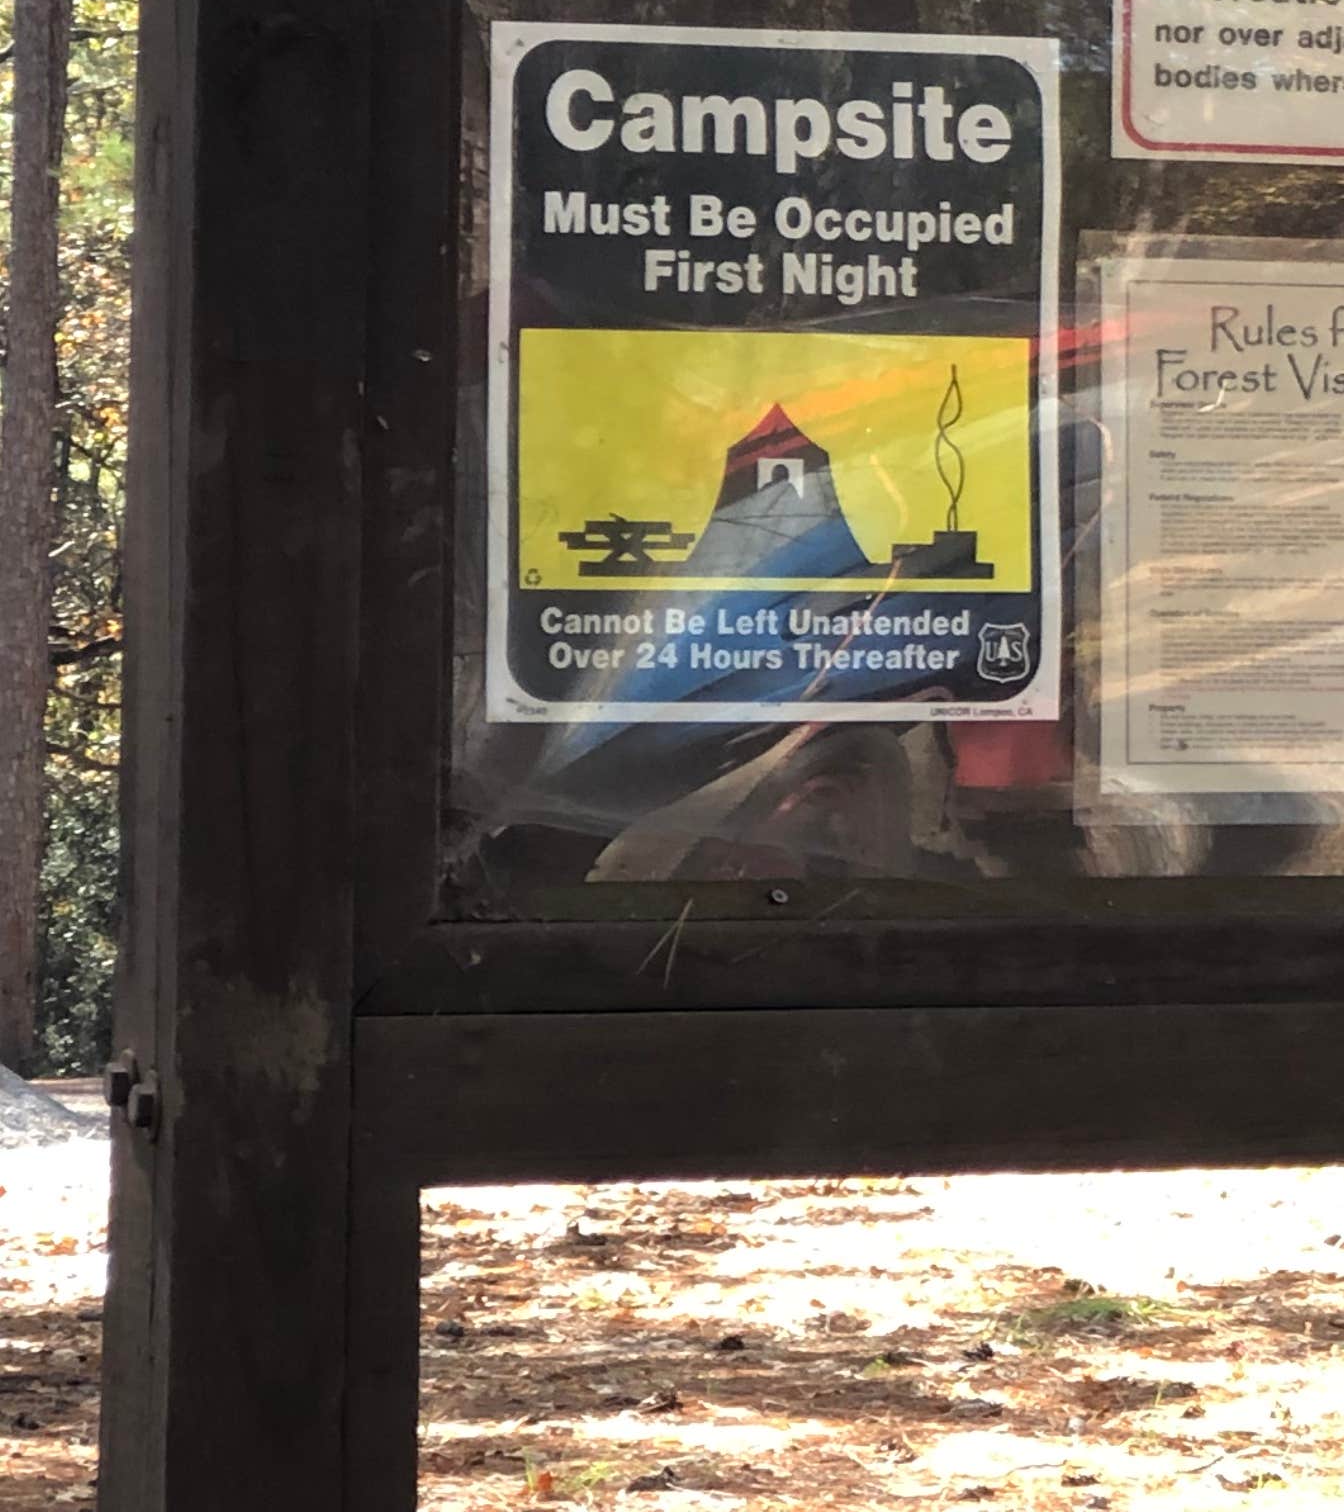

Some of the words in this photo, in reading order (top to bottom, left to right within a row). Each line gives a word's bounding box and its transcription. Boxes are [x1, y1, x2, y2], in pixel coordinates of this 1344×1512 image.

[1154, 25, 1204, 46] nor
[1218, 25, 1284, 48] over
[1153, 63, 1258, 90] bodies
[545, 68, 1012, 174] Campsite
[543, 191, 671, 236] Must
[689, 194, 757, 239] Be
[774, 196, 1014, 251] Occupied
[644, 250, 763, 293] First
[781, 254, 918, 305] Night
[1210, 303, 1319, 353] Rules
[1155, 348, 1277, 398] Forest
[540, 607, 653, 636] Cannot
[664, 608, 706, 636] Be
[717, 608, 778, 636] Left
[788, 609, 970, 637] Unattended
[548, 642, 625, 670] Over
[636, 642, 678, 670] 24
[690, 643, 783, 670] Hours
[795, 643, 959, 671] Thereafter
